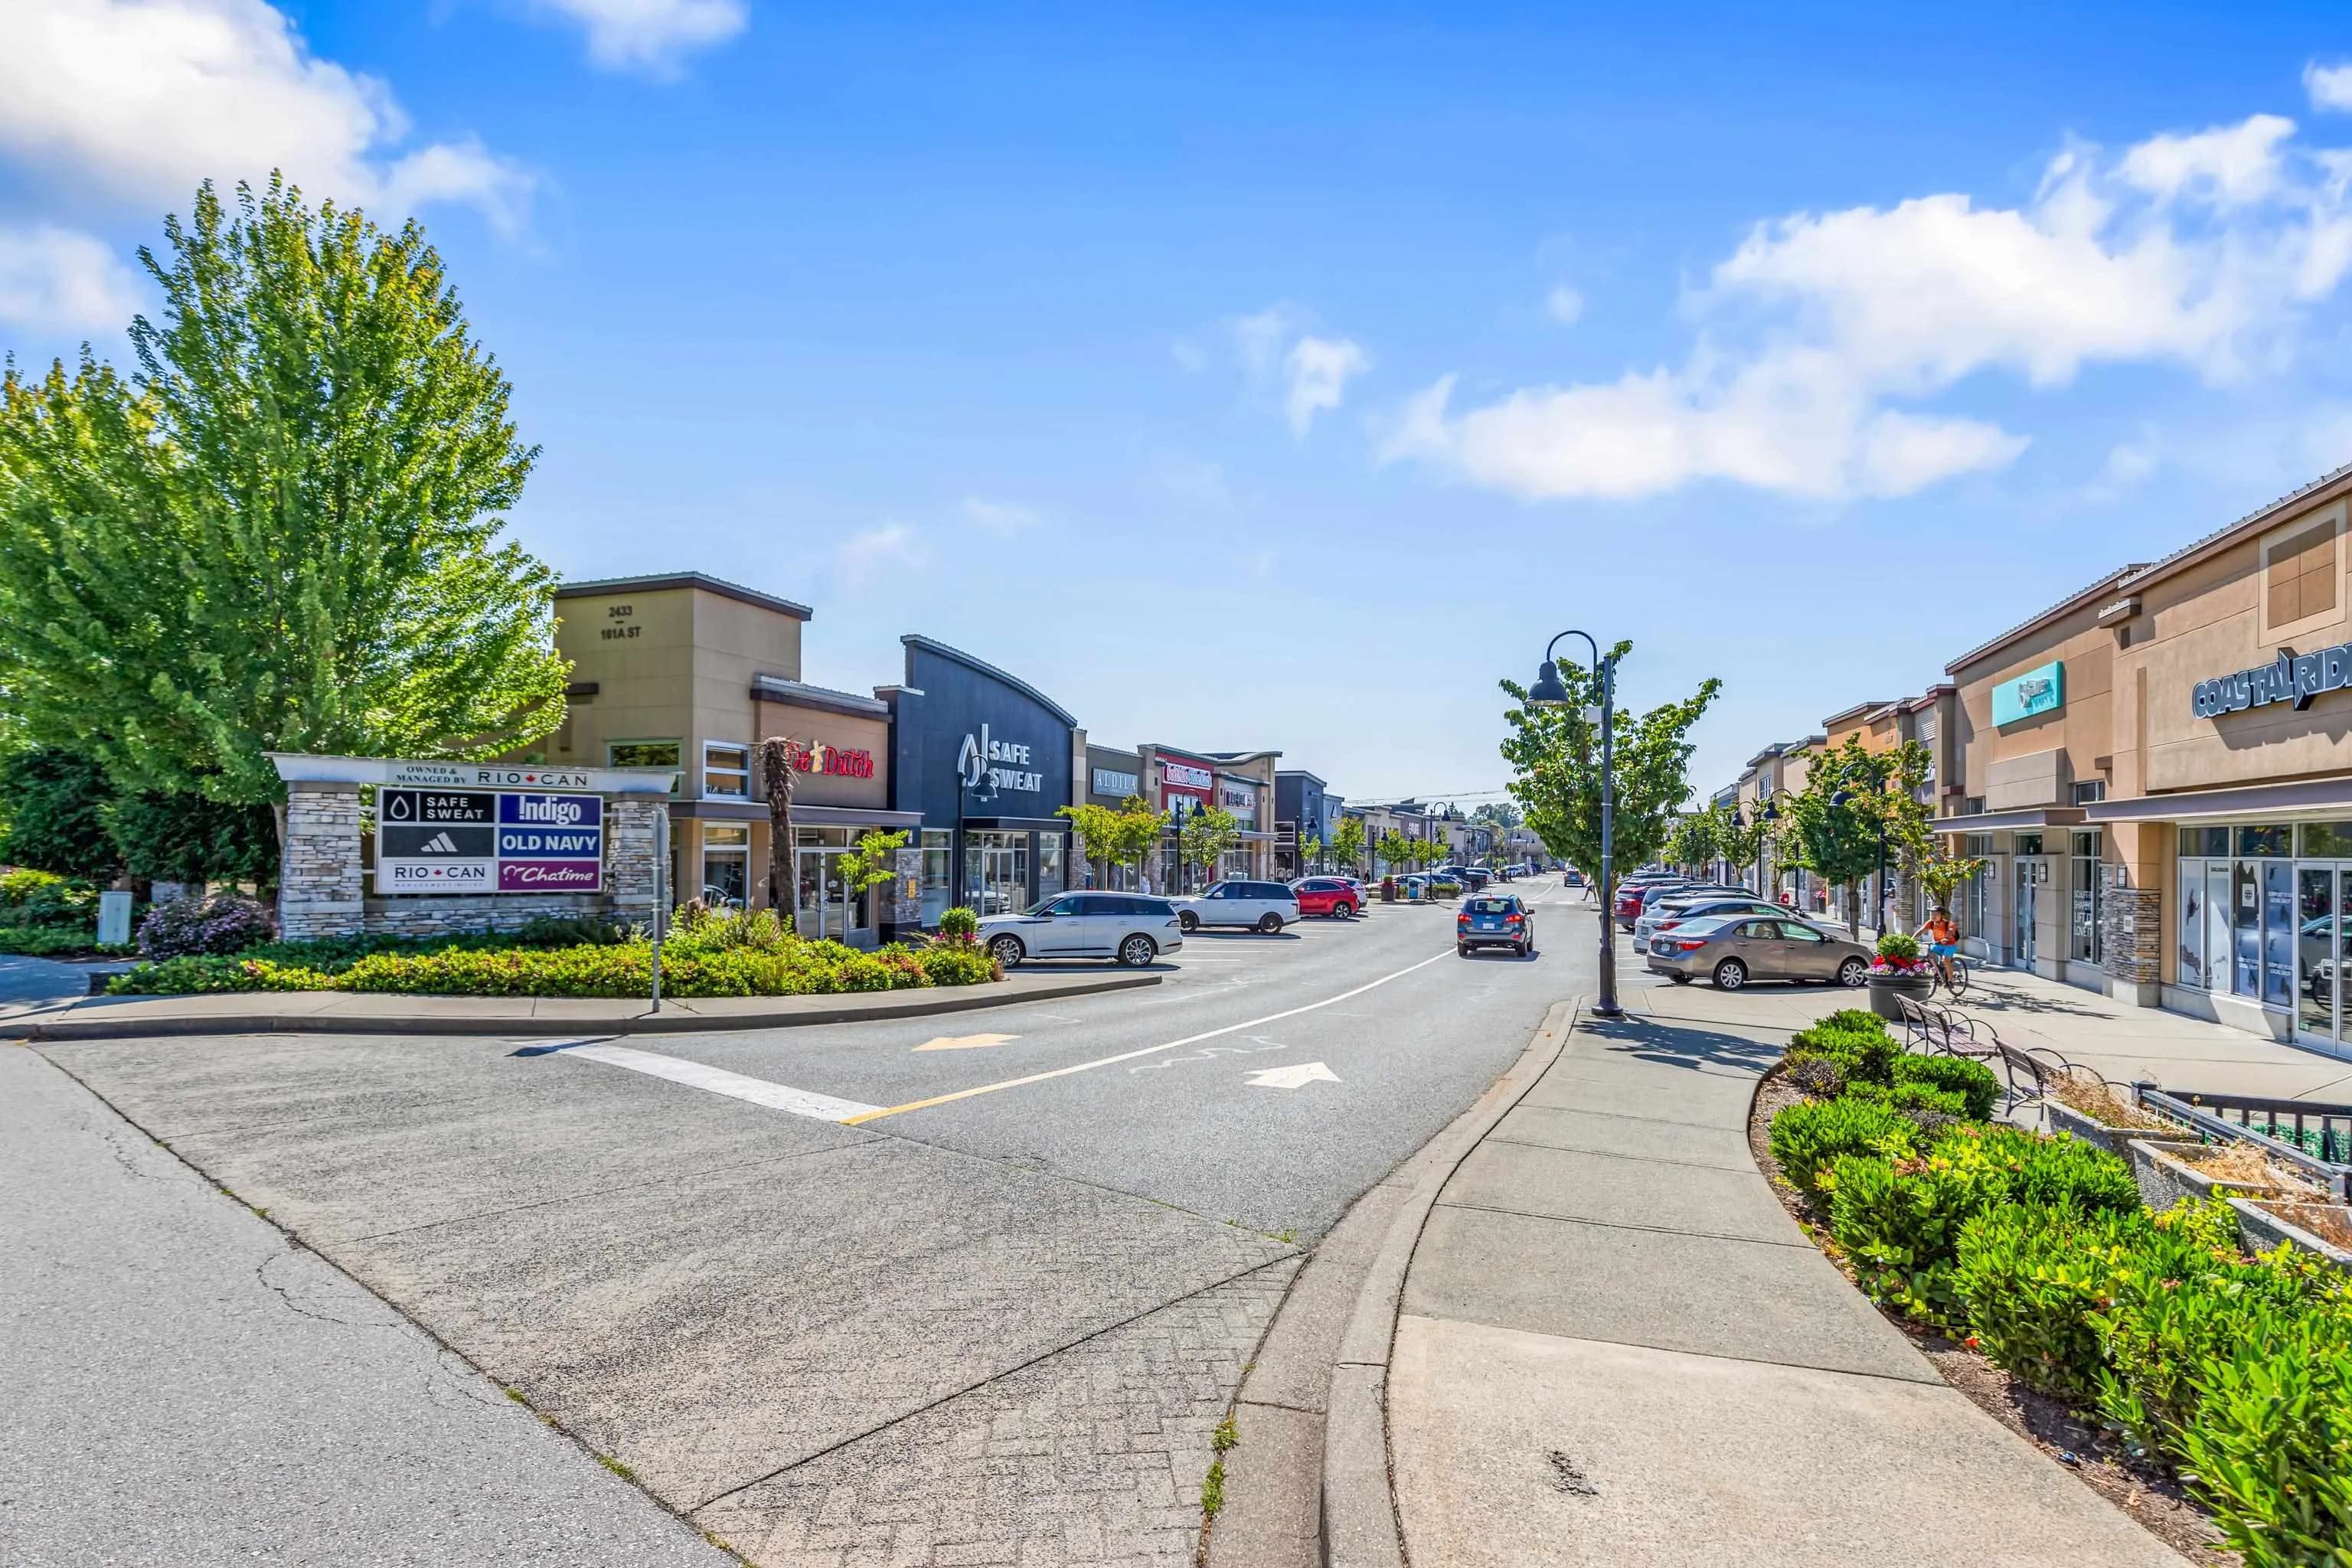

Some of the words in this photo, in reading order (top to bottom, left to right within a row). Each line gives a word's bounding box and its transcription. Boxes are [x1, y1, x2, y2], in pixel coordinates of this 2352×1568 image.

[609, 606, 632, 617] 2433
[627, 626, 642, 638] ST
[2193, 647, 2294, 720] COASTAL
[988, 740, 1030, 765] SAFE
[822, 746, 874, 778] Dutch
[407, 766, 446, 774] OWNED
[396, 774, 450, 783] MANAGED
[453, 776, 468, 785] BY
[478, 771, 521, 783] RIO
[541, 773, 587, 786] CAN
[989, 767, 1043, 792] SWEAT
[1096, 772, 1136, 791] ALDILA
[426, 796, 469, 807] SAFE
[426, 808, 485, 820] SWEAT
[518, 795, 582, 825] Indigo
[501, 835, 544, 851] OLD
[545, 835, 597, 851] NAVY
[395, 867, 428, 878] RIO
[446, 867, 485, 878] CAN
[521, 867, 595, 882] Chatime
